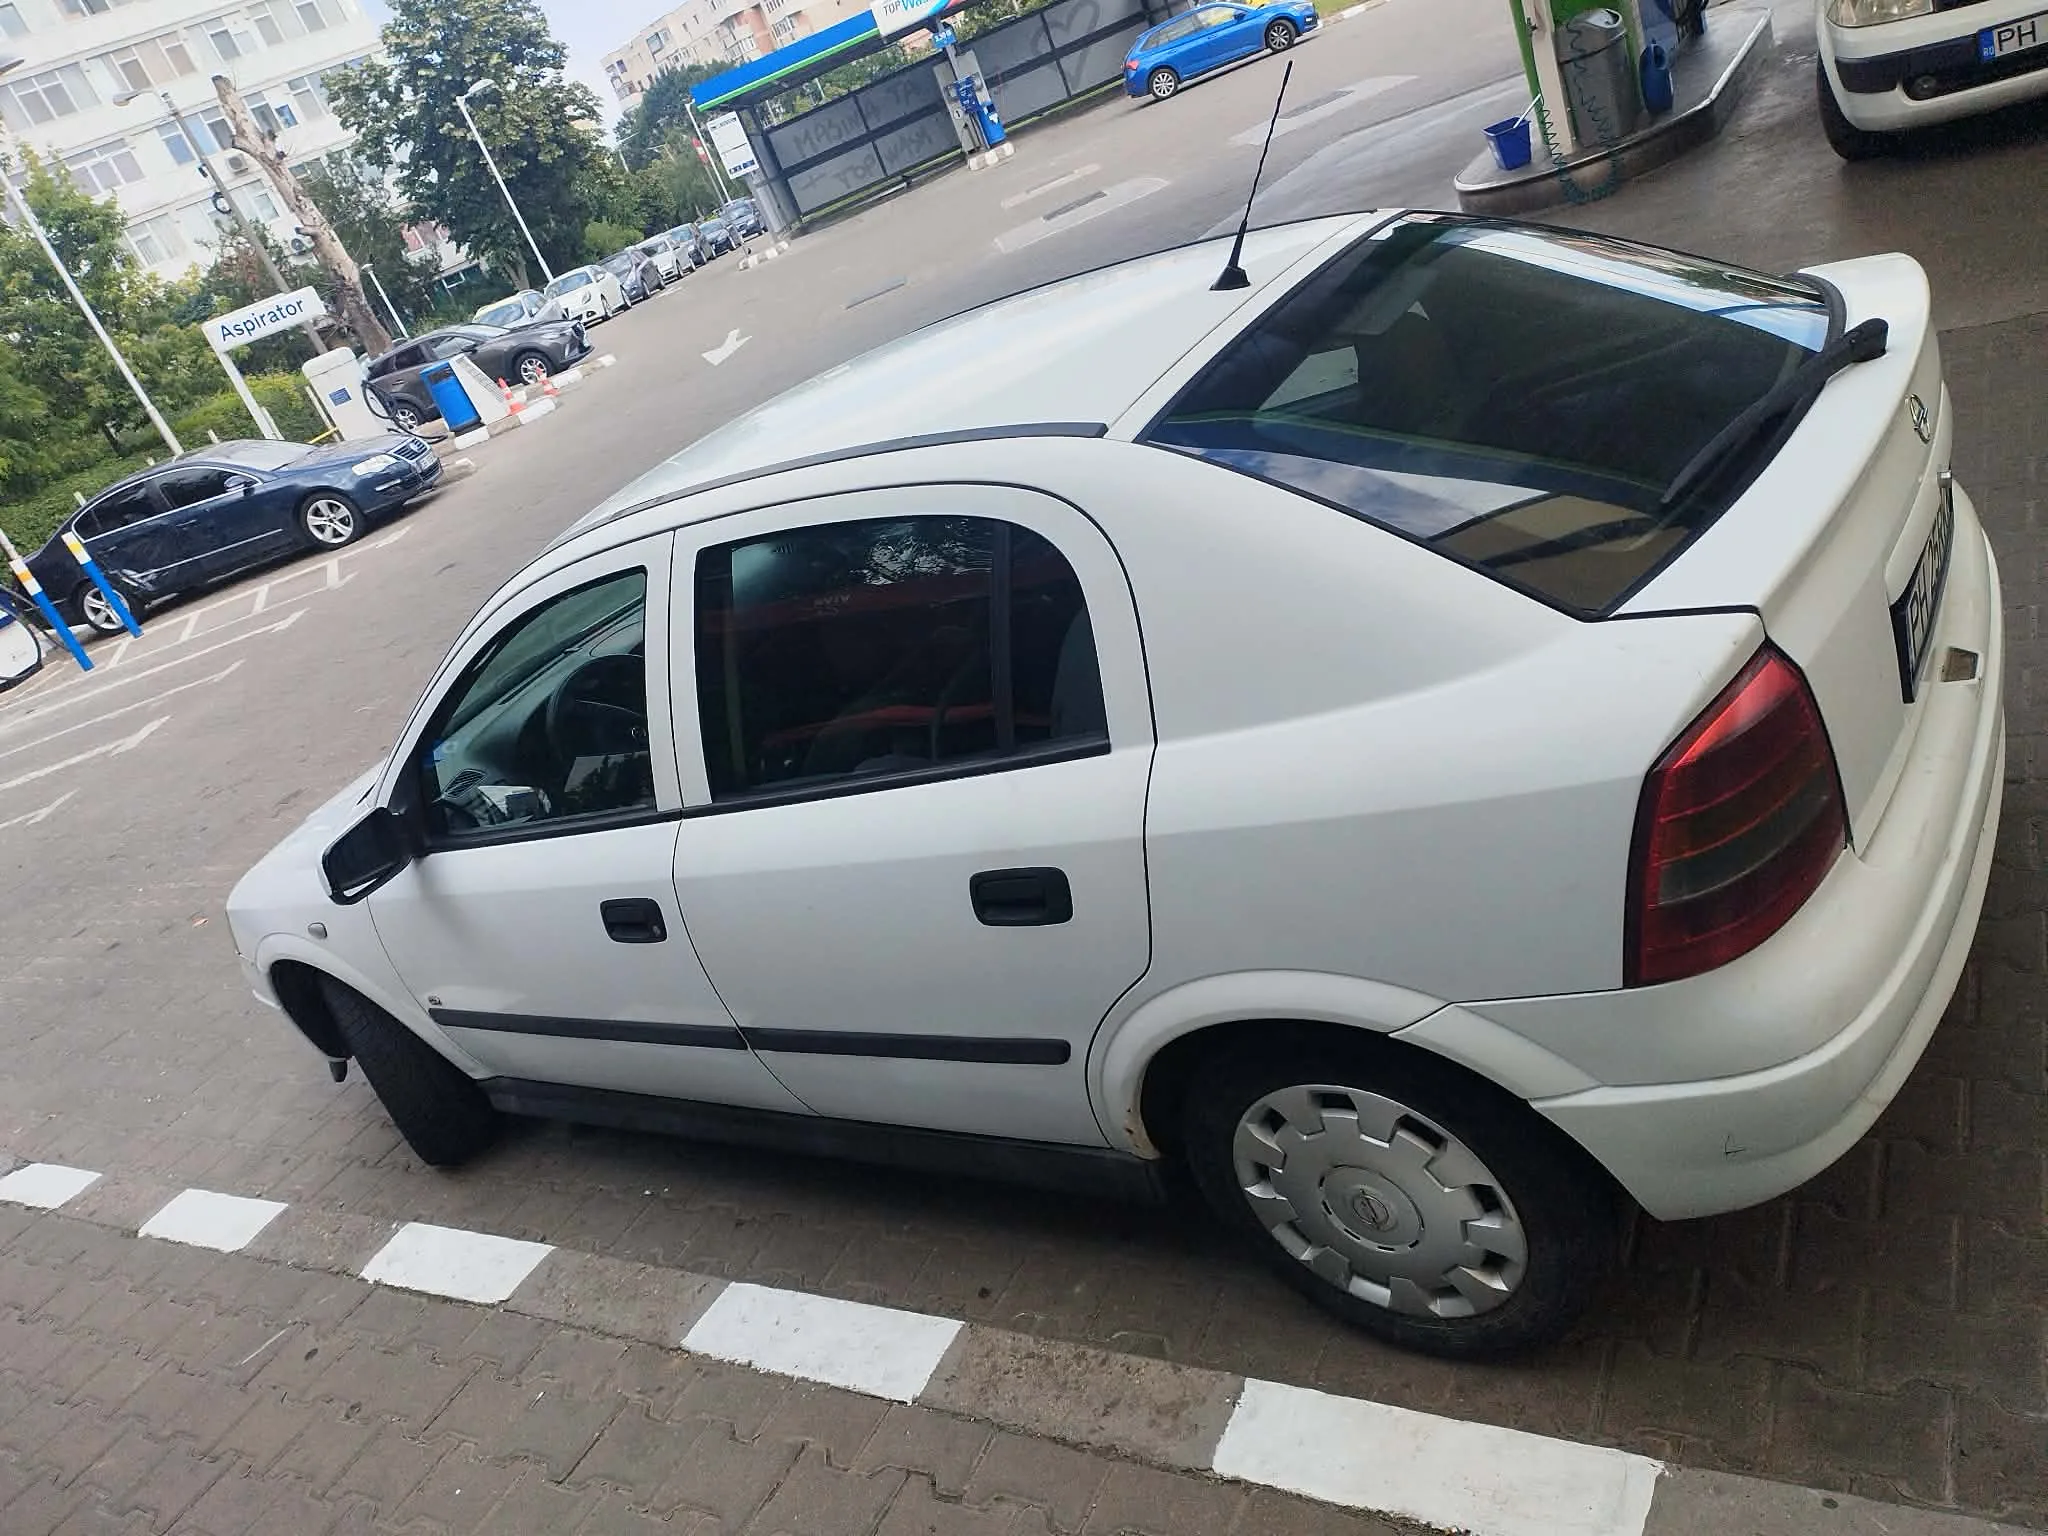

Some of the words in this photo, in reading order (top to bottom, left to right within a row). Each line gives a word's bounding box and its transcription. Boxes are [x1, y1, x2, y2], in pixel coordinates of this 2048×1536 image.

[883, 1, 901, 16] TOP
[901, 0, 929, 11] Wa
[1997, 20, 2037, 52] PH
[220, 299, 304, 342] Aspirator
